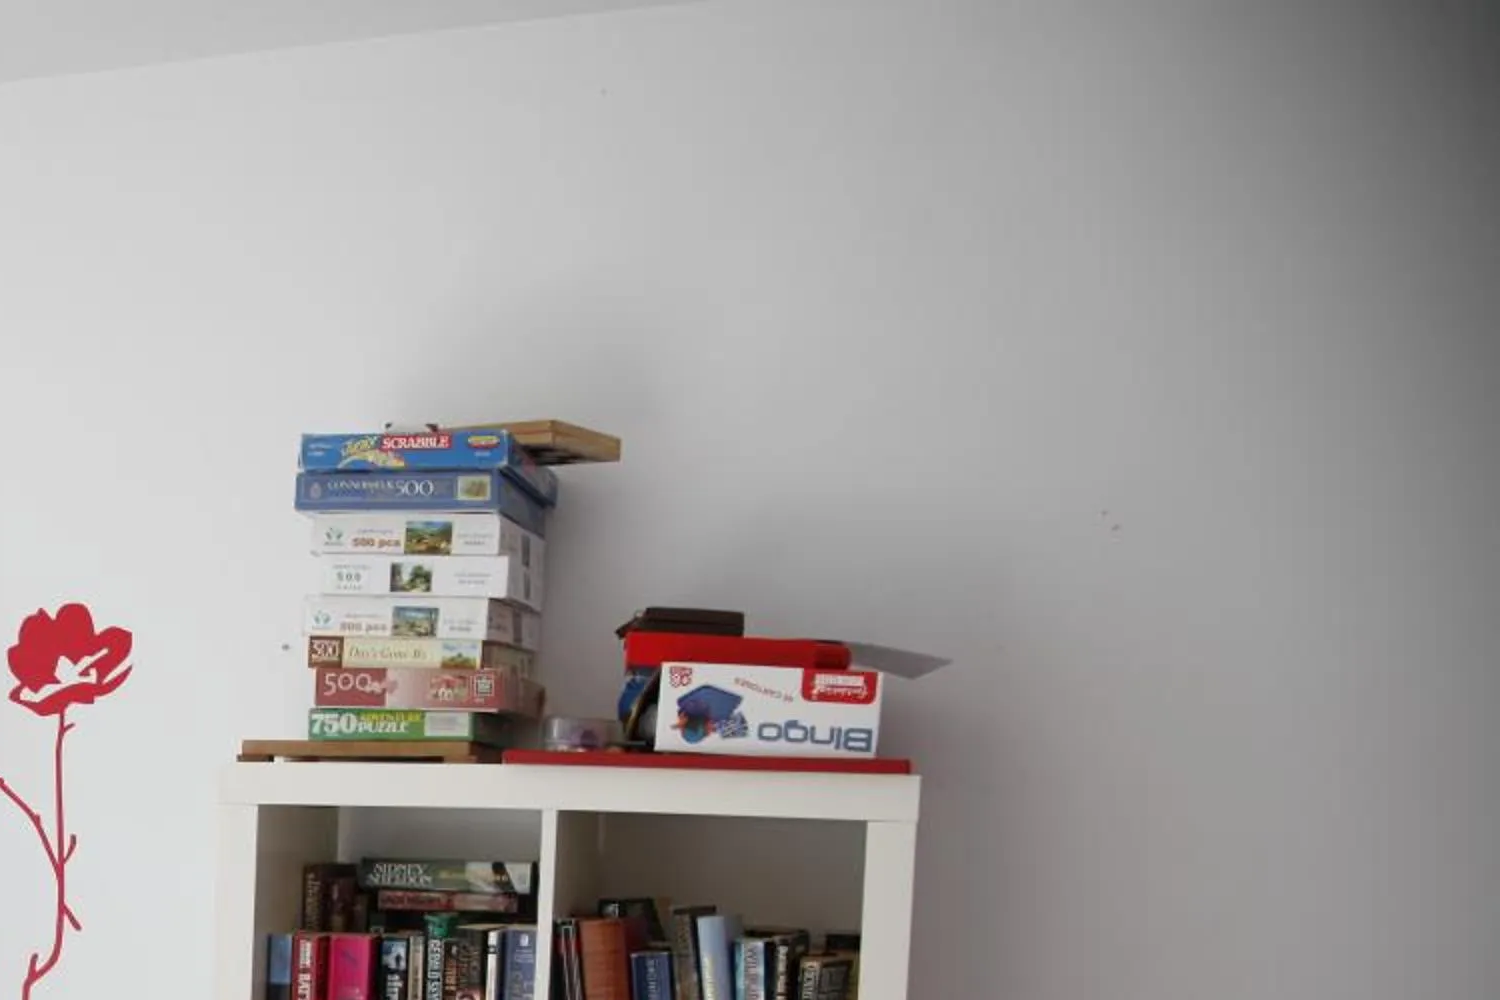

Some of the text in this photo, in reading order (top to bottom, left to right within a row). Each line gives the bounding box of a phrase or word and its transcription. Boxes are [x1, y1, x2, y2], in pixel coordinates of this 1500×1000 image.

[381, 435, 450, 450] SCRABBLE
[323, 673, 372, 696] 500
[311, 712, 357, 734] 750
[757, 719, 874, 753] Bingo
[427, 939, 443, 979] GERALD
